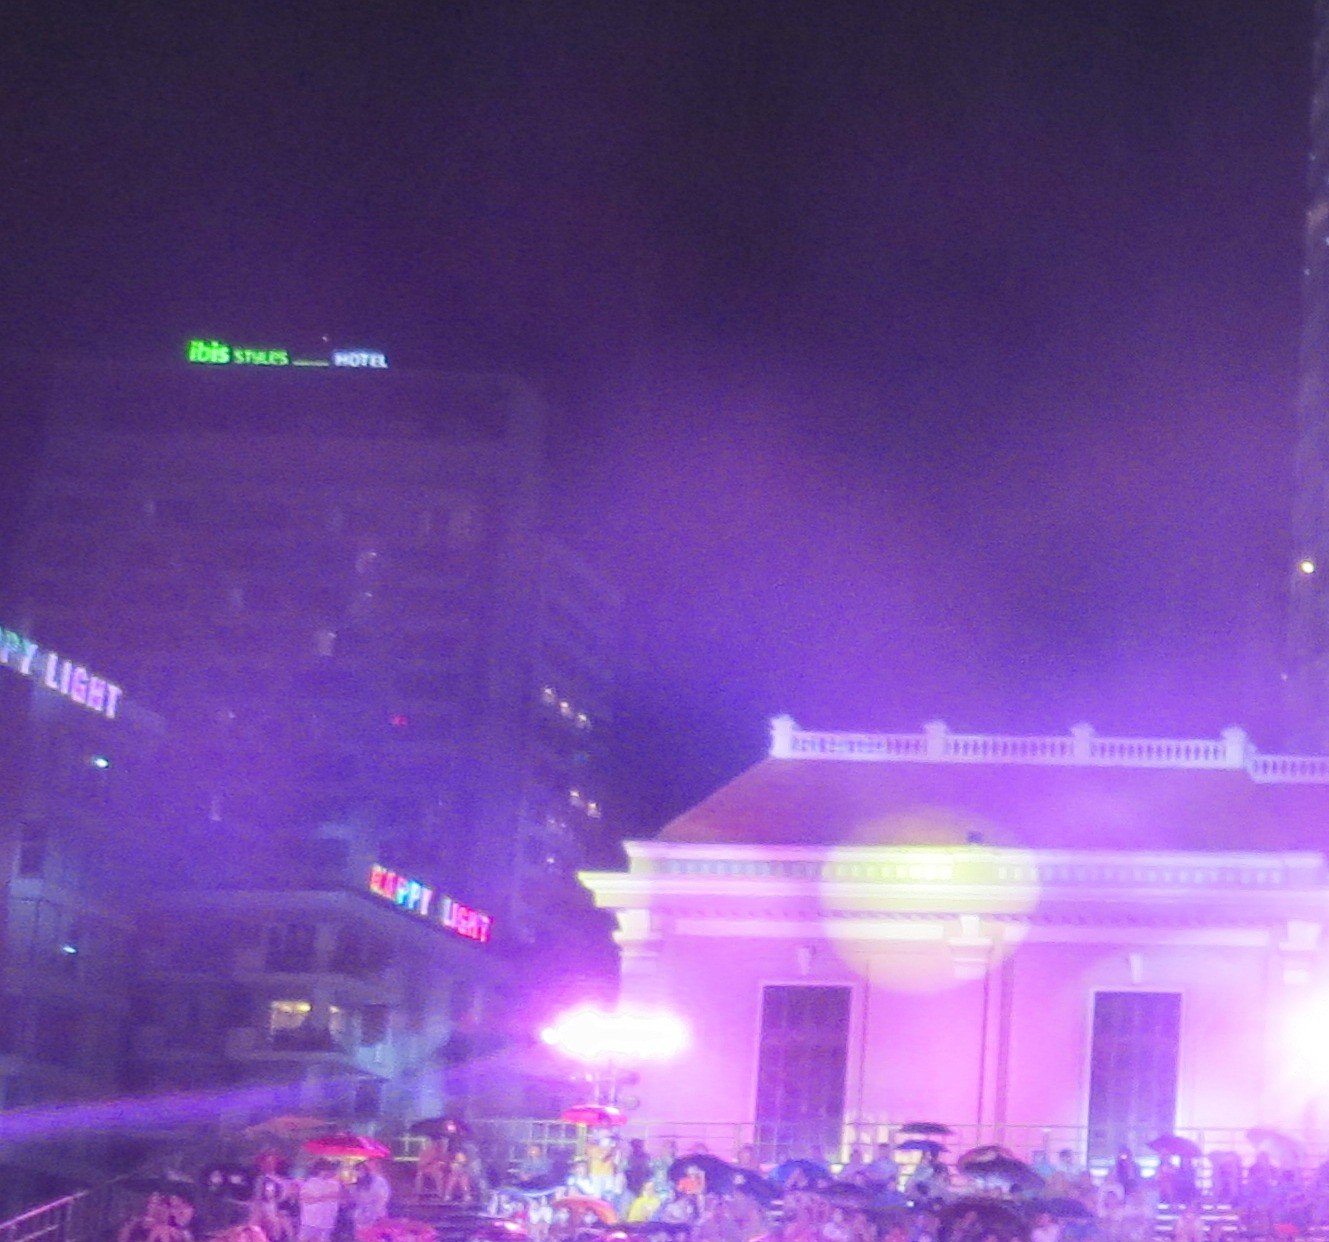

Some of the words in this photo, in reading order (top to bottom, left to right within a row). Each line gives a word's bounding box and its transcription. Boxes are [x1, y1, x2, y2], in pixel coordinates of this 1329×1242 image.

[189, 339, 231, 363] ibis
[234, 348, 289, 365] STYLES
[334, 351, 388, 368] HOTEL
[45, 651, 123, 719] LIGHT
[370, 863, 432, 915] HAPPY
[442, 896, 492, 942] LIGHT
